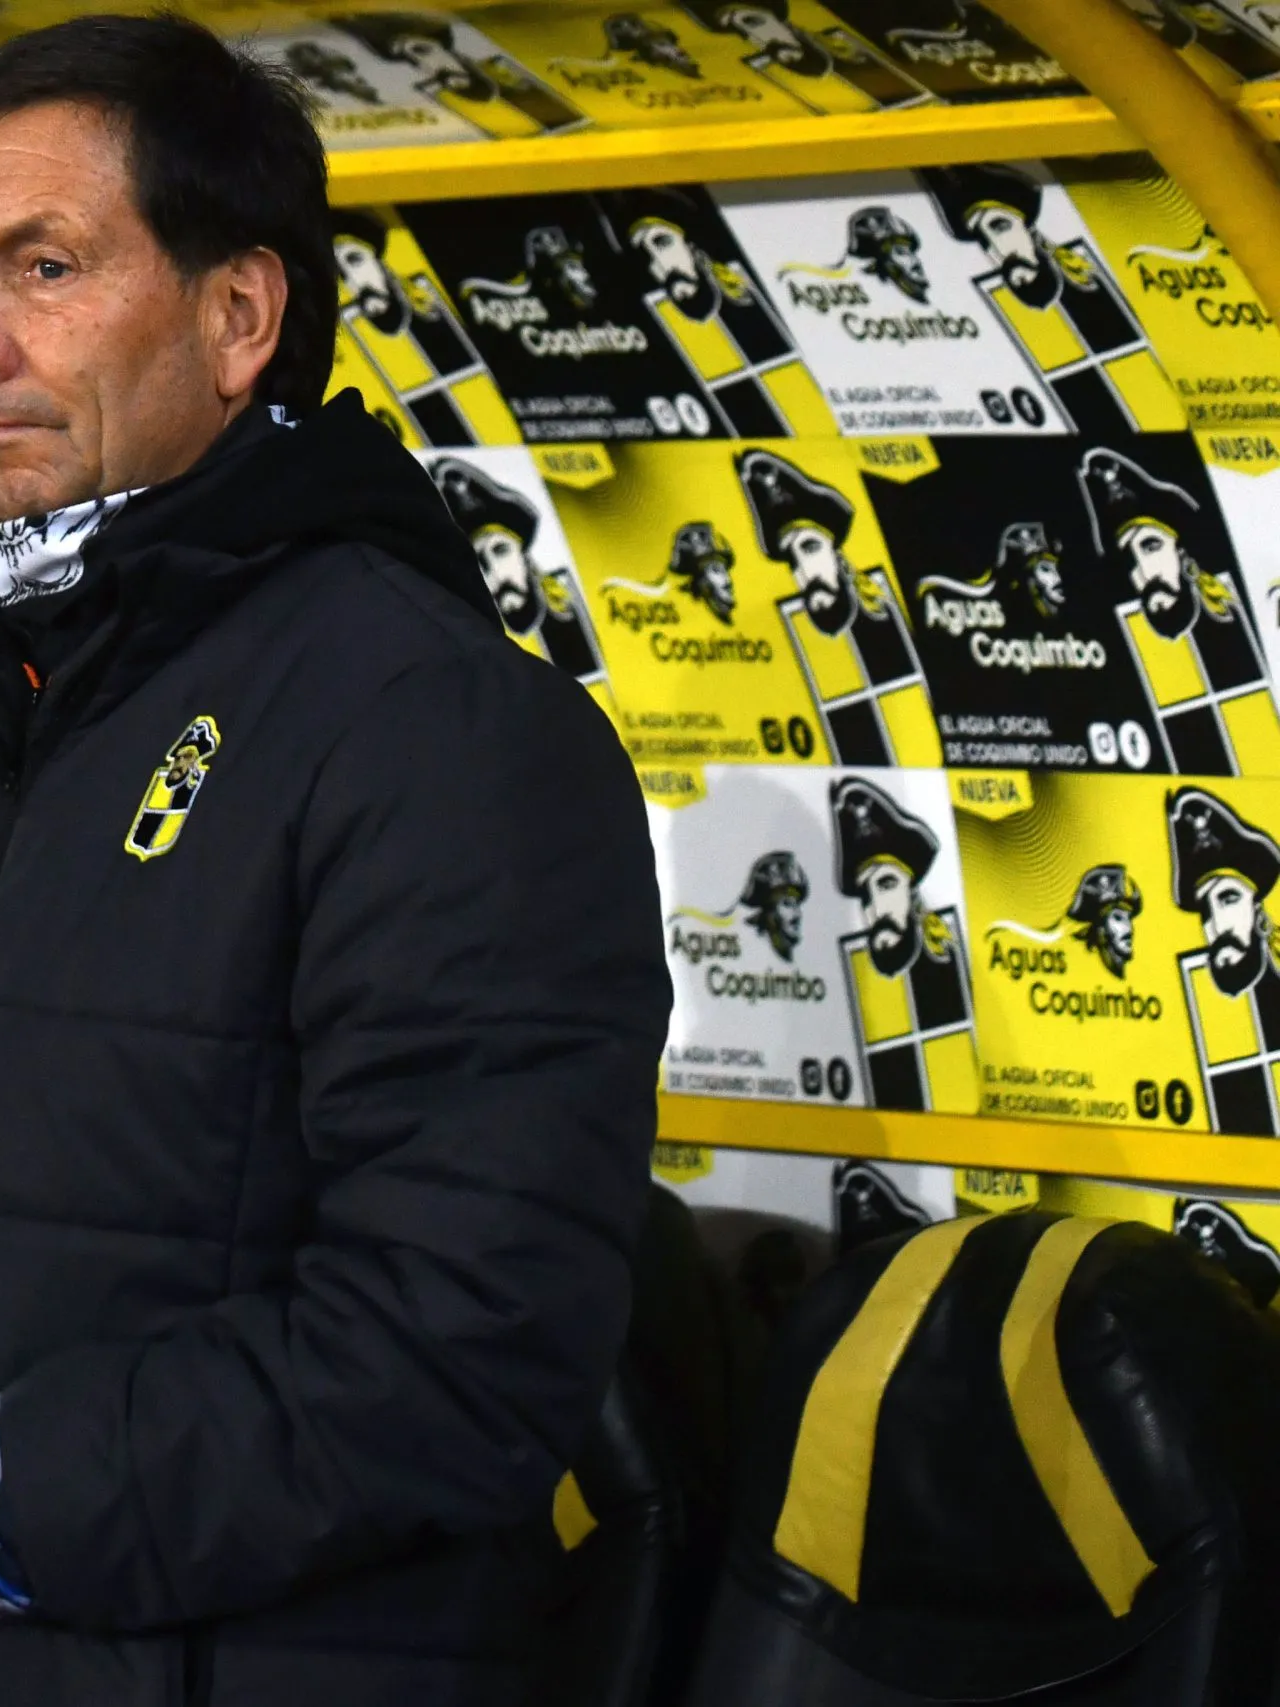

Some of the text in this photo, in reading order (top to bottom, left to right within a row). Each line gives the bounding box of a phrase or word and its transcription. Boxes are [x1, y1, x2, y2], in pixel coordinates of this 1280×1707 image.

[787, 280, 870, 314] Aguas
[1139, 262, 1226, 299] Aguas
[472, 294, 549, 331] Aguas
[839, 308, 979, 348] Coquimbo
[520, 320, 649, 360] Coquimbo
[861, 442, 926, 466] NUEVA
[1209, 437, 1280, 463] NUEVA
[608, 598, 680, 632] Aguas
[924, 593, 1005, 636] Aguas
[650, 632, 773, 669] Coquimbo
[970, 632, 1107, 675] Coquimbo
[959, 777, 1021, 803] NUEVA
[672, 927, 741, 964] Aguas
[989, 941, 1067, 980] Aguas
[707, 965, 827, 1005] Coquimbo
[1030, 982, 1163, 1023] Coquimbo
[965, 1168, 1029, 1197] NUEVA
